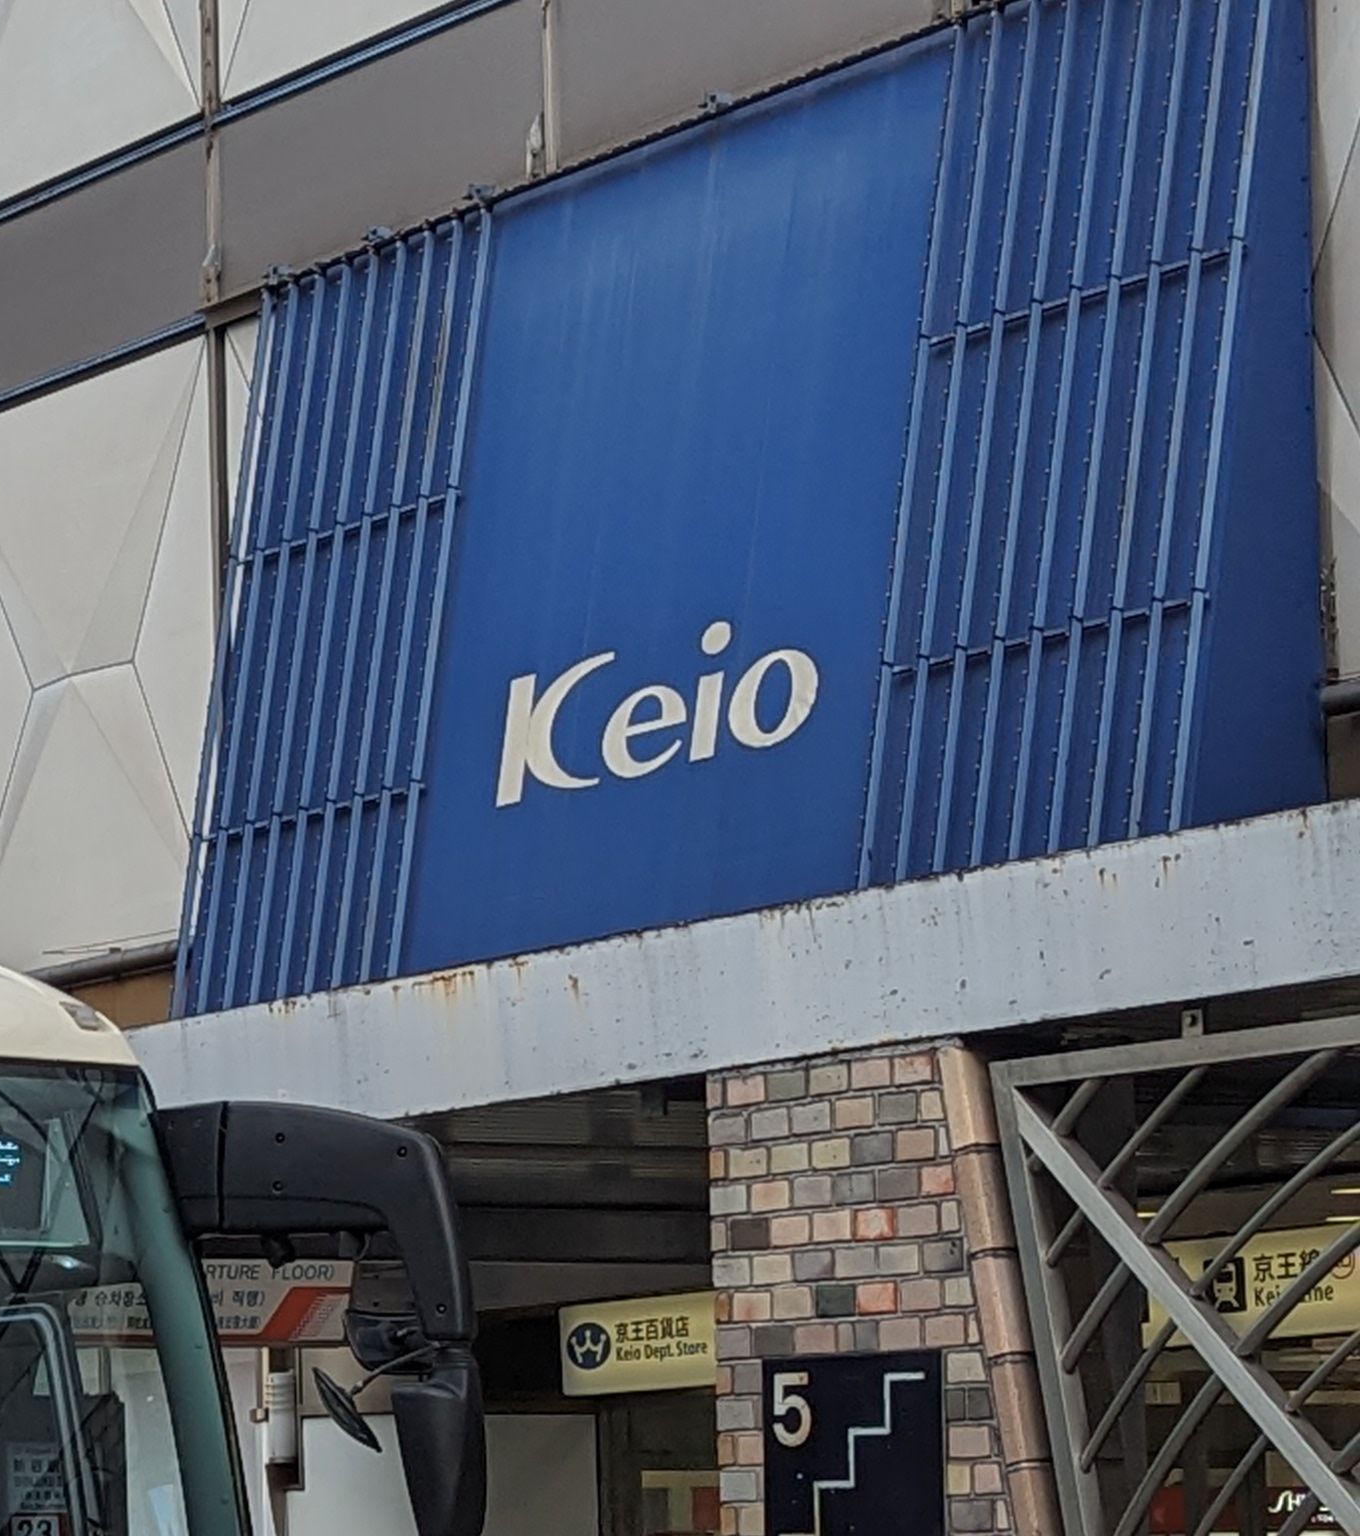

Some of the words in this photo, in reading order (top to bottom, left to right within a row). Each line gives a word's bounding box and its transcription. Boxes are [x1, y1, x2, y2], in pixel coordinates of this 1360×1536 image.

[495, 621, 820, 809] Keio
[614, 1315, 690, 1344] 京王百貨店
[615, 1345, 641, 1362] Keio
[644, 1343, 675, 1362] Dept.
[676, 1340, 708, 1358] Store
[772, 1371, 812, 1448] 5
